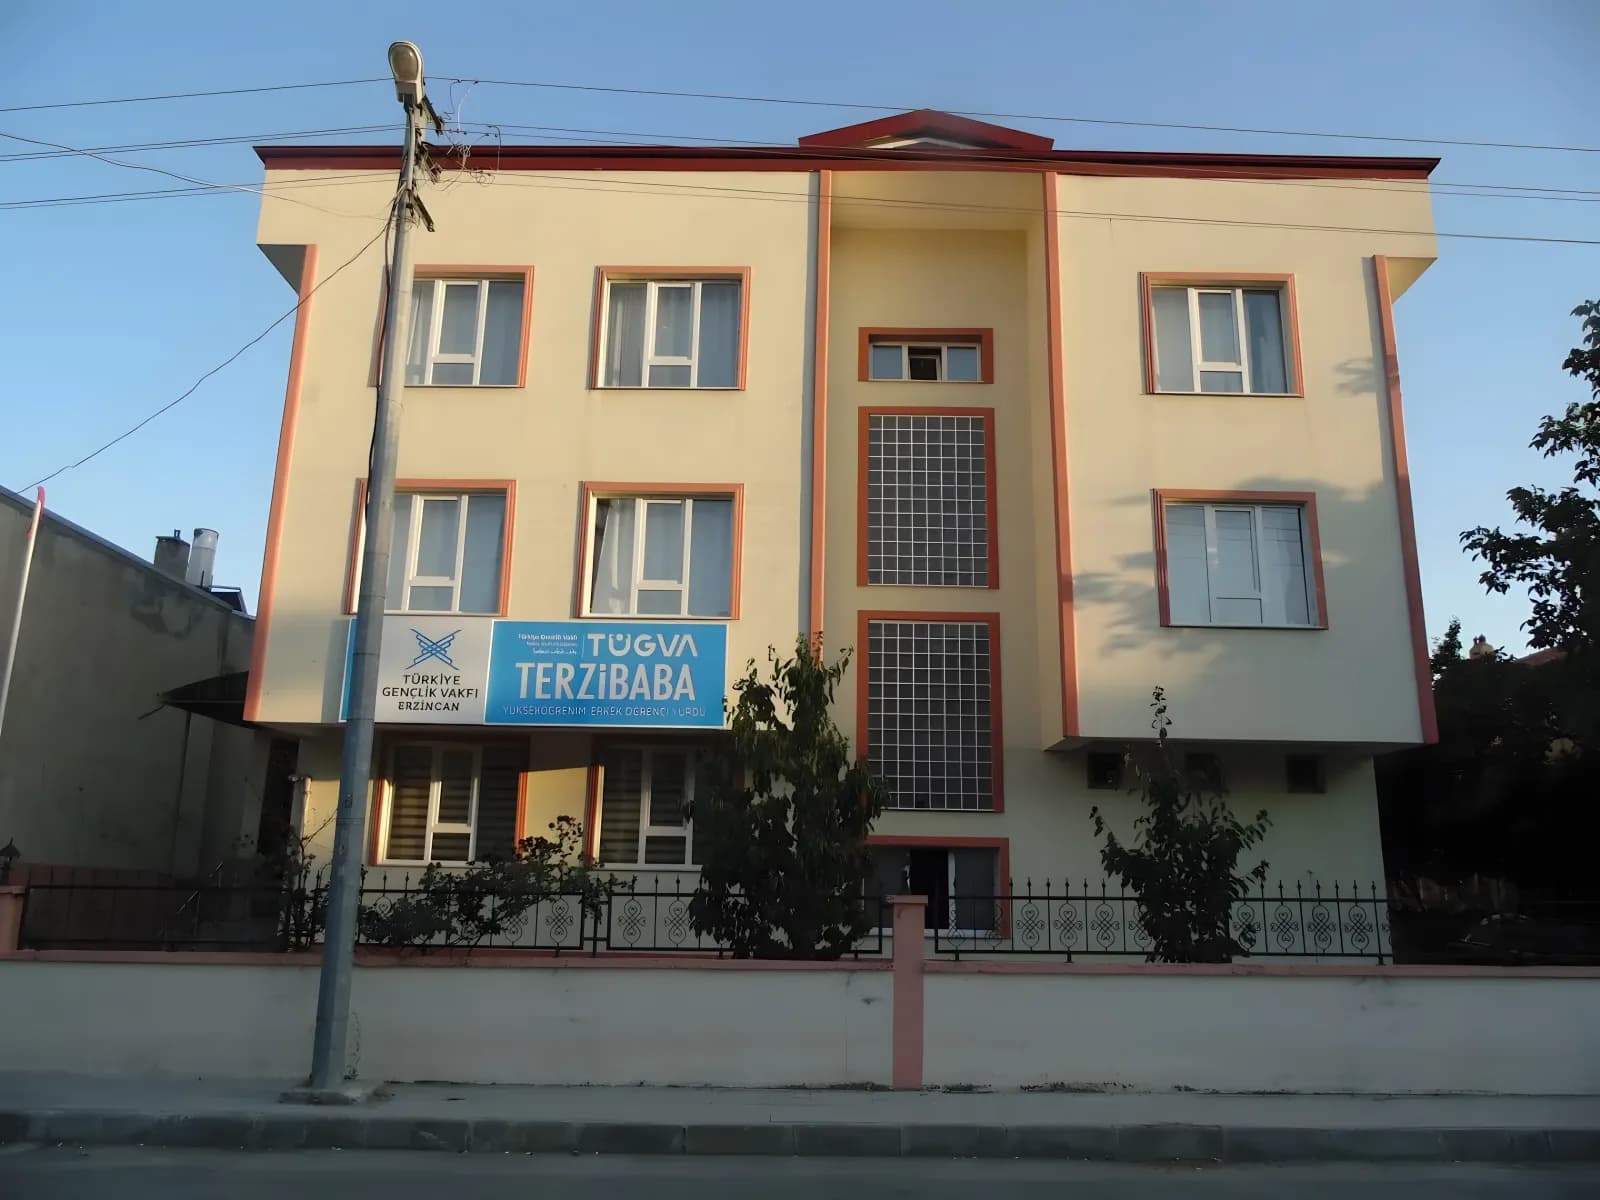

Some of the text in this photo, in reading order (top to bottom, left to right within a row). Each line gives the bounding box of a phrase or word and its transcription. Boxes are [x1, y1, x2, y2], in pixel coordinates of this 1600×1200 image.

[587, 633, 698, 657] TÜGVA
[403, 673, 461, 685] TÜRKİYE
[382, 686, 479, 699] GENÇLİK VAKFI
[398, 700, 459, 711] ERZİNCAN
